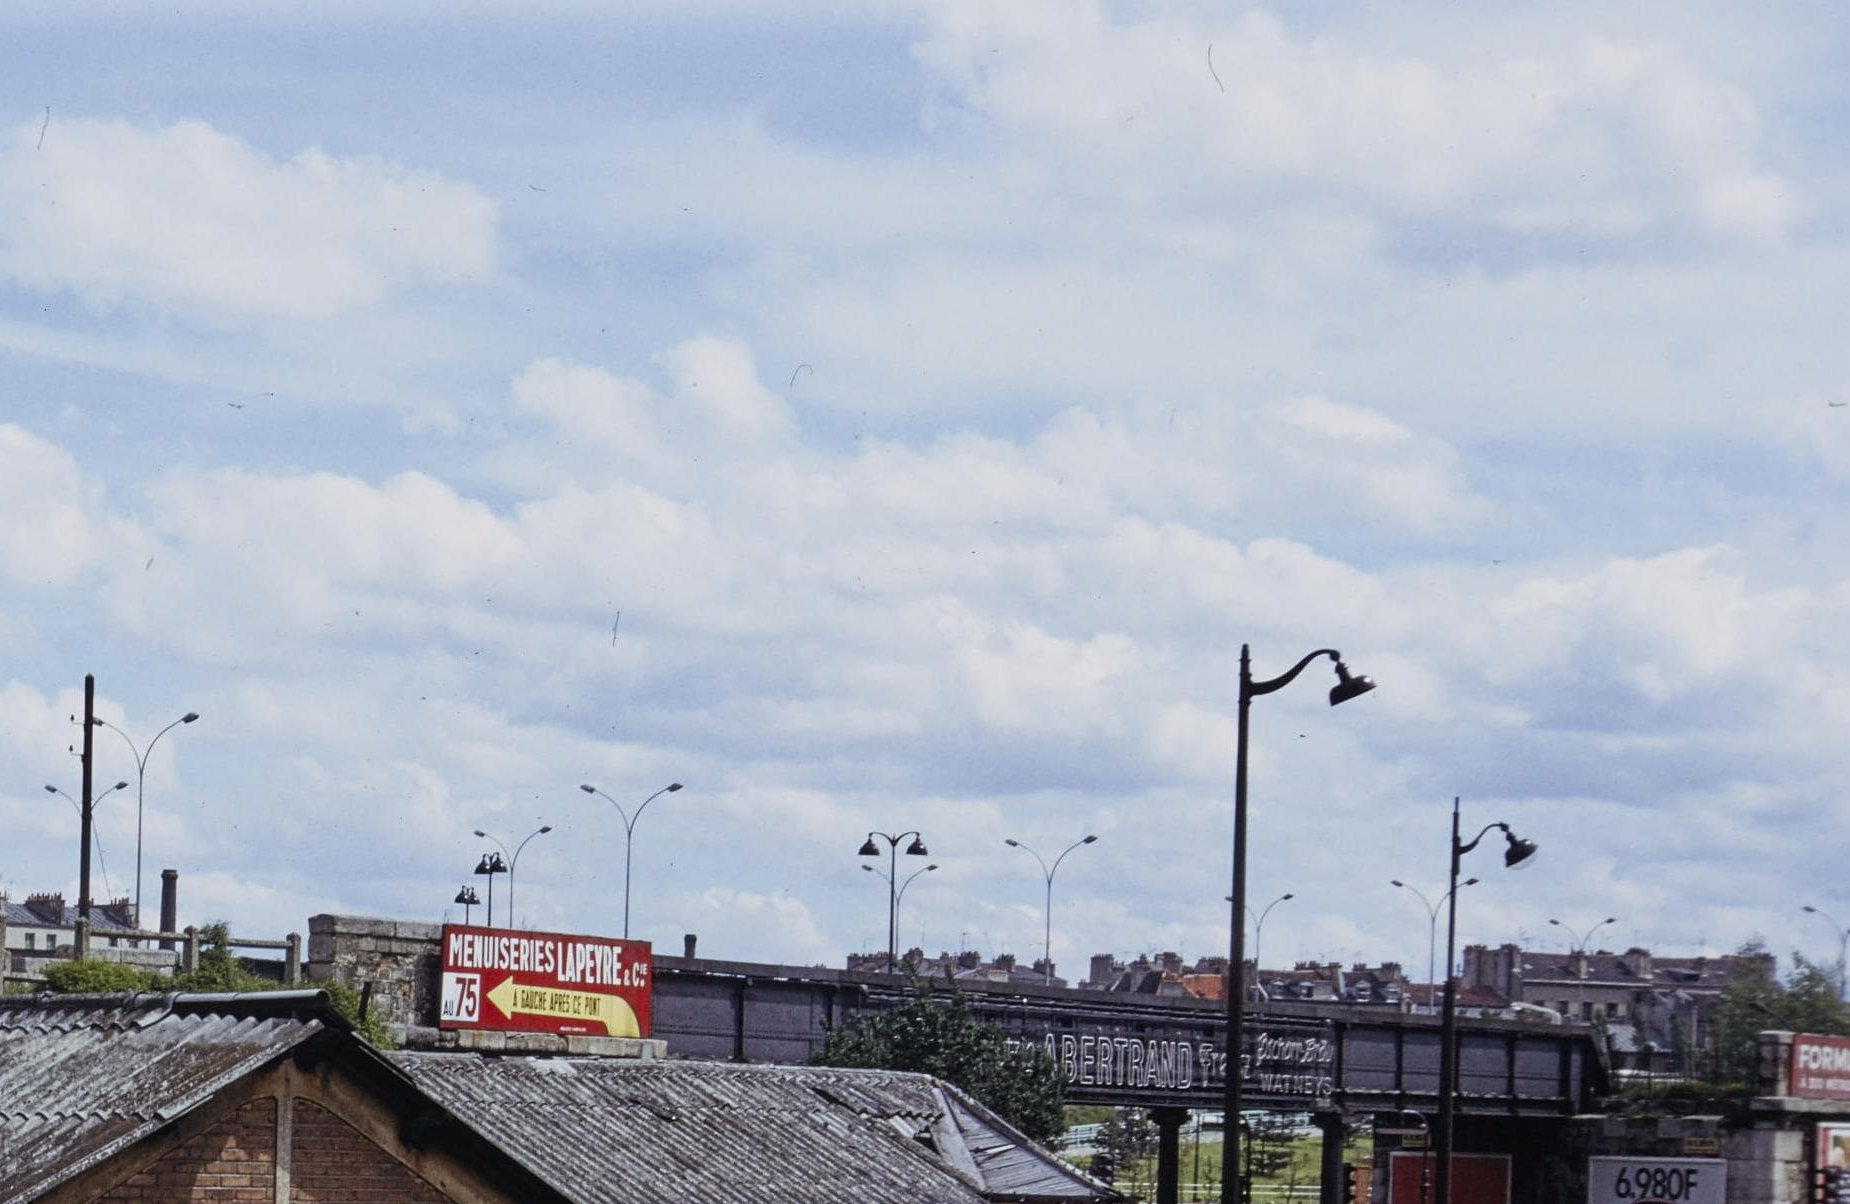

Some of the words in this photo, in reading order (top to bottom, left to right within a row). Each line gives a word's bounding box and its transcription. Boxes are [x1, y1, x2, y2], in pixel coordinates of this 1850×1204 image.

[448, 933, 555, 973] MENUISERIES
[557, 942, 622, 986] LAPEYRE
[623, 969, 631, 986] &
[443, 1000, 454, 1017] AU
[455, 977, 478, 1017] 75
[512, 988, 518, 1007] A
[521, 989, 547, 1010] GAUCHE
[573, 995, 582, 1014] CE
[584, 996, 601, 1016] PONT
[1062, 1034, 1192, 1089] BERTRAND
